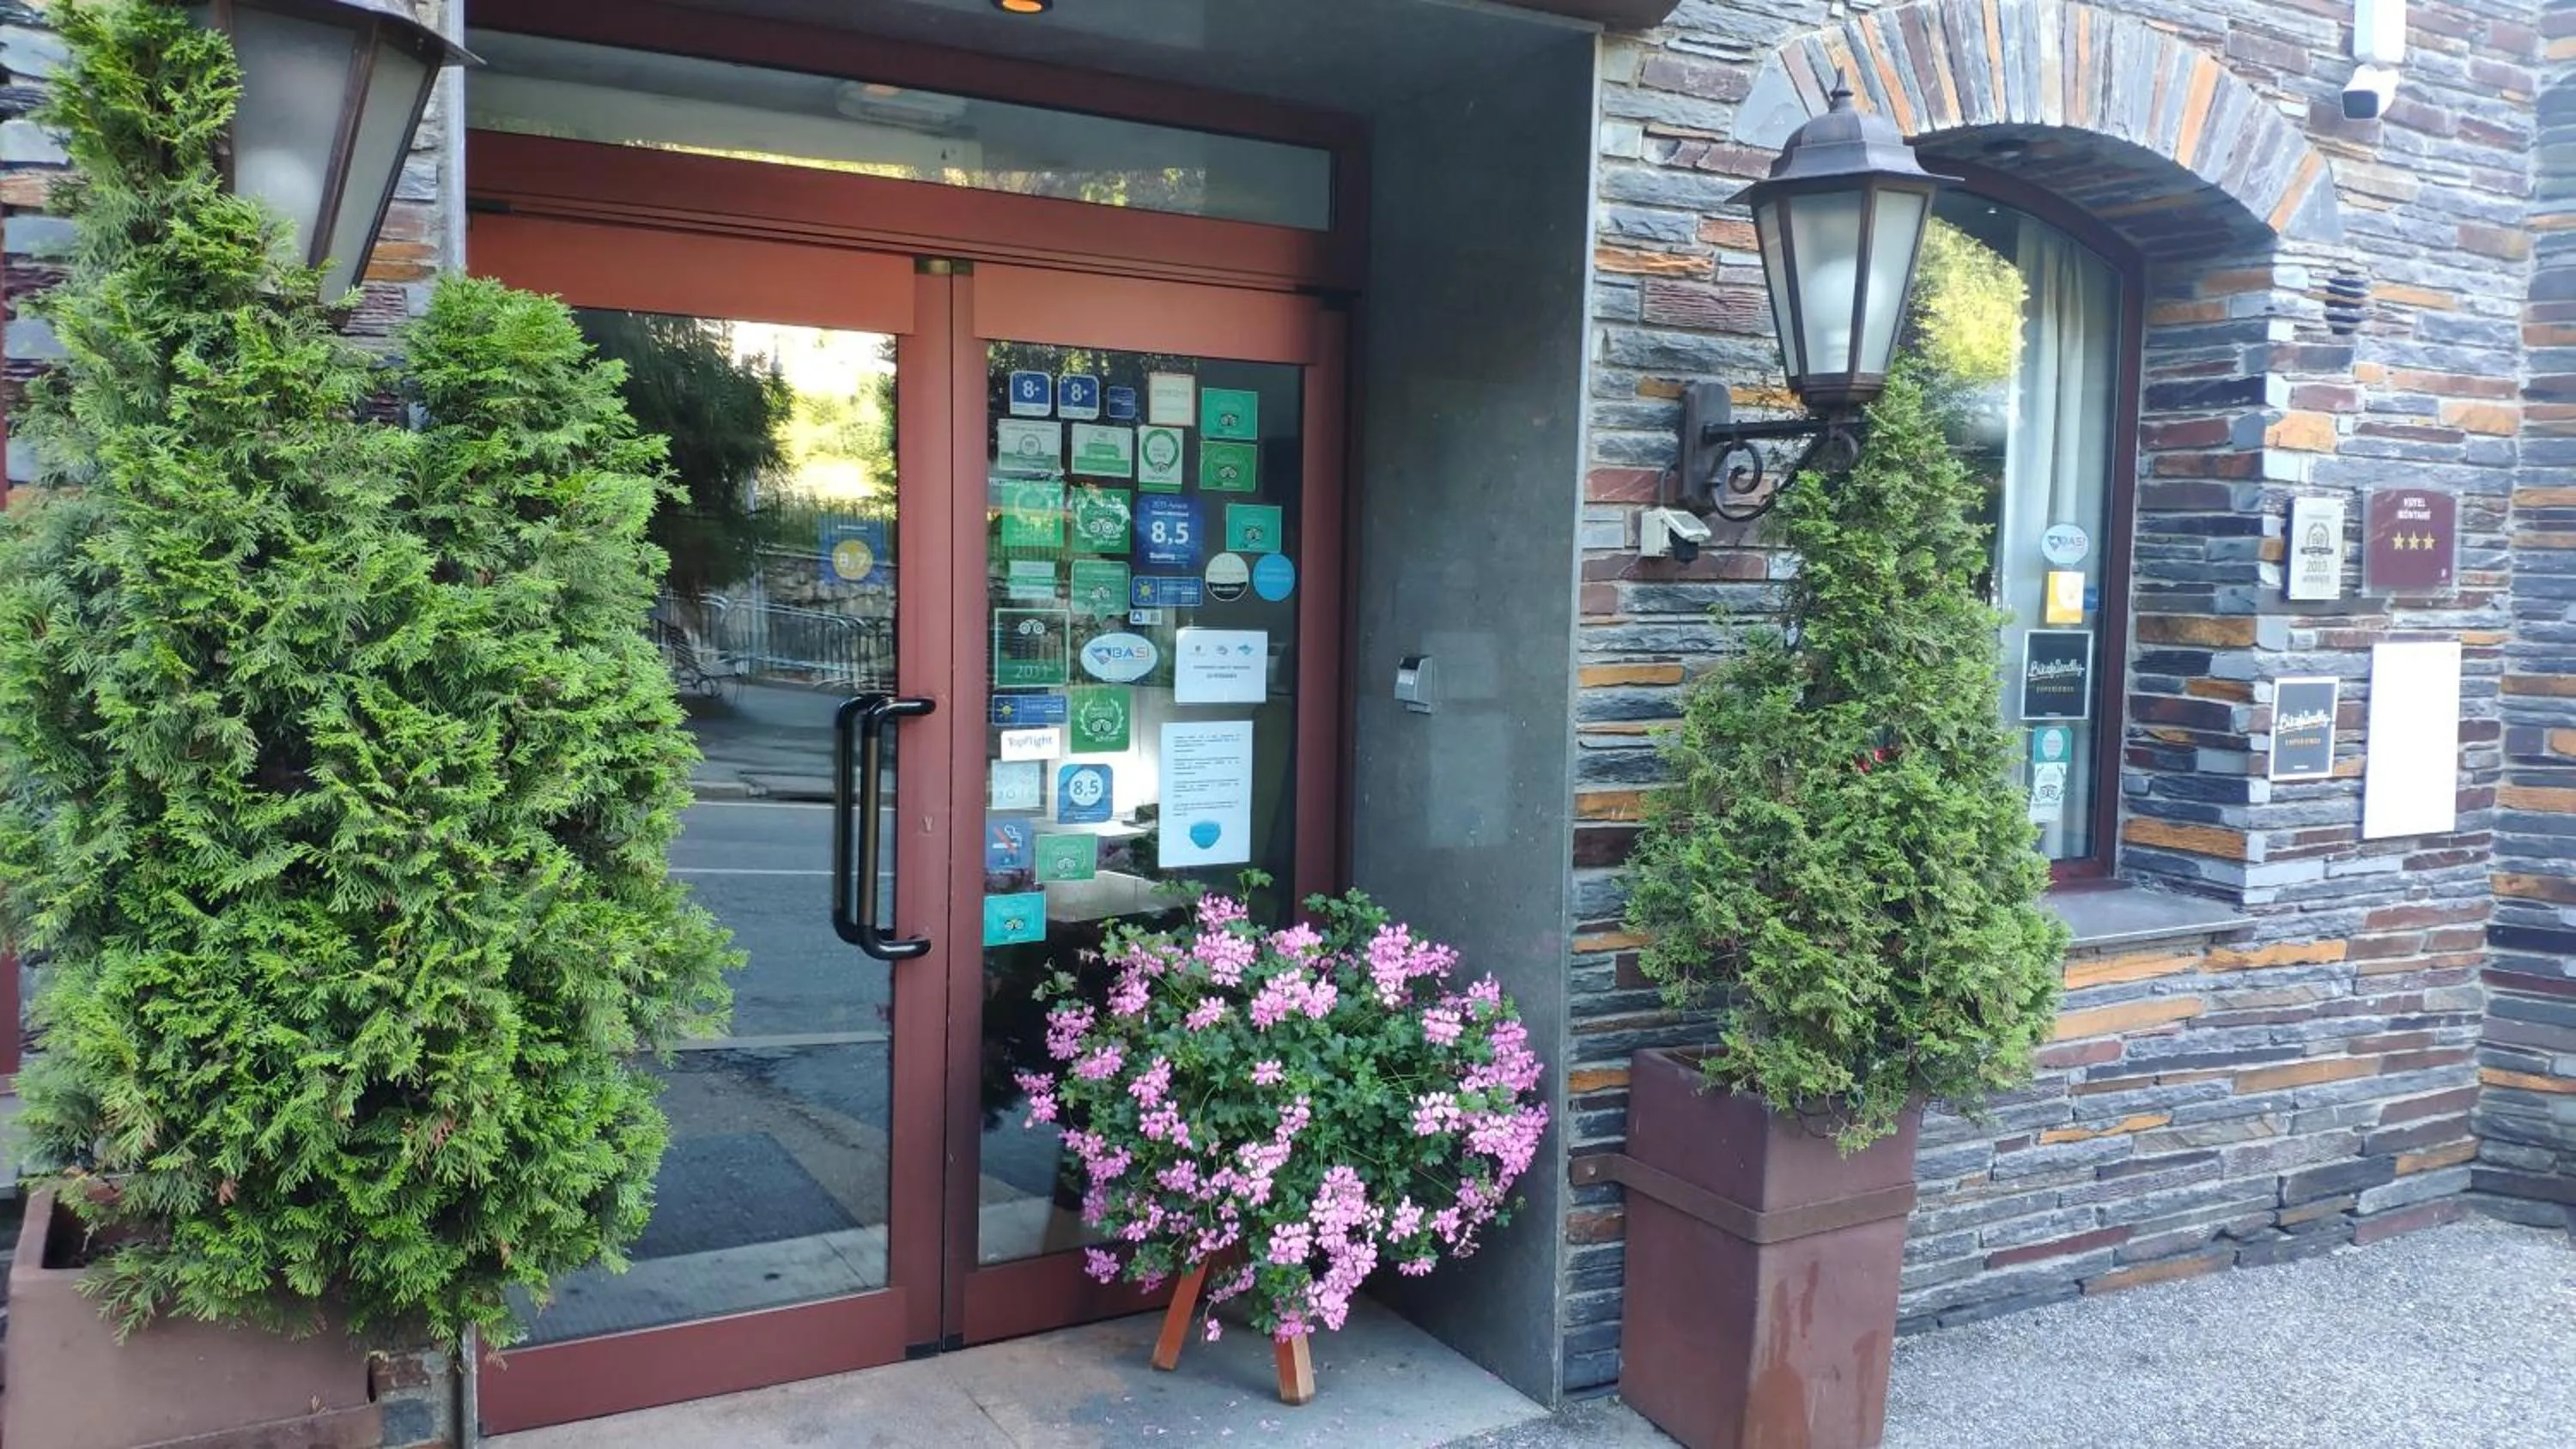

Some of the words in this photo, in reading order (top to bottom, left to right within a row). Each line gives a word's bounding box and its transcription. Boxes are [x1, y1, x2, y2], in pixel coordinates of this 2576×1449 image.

[1151, 521, 1189, 545] 8,5
[1112, 646, 1150, 658] BASI
[1073, 779, 1099, 797] 8,5
